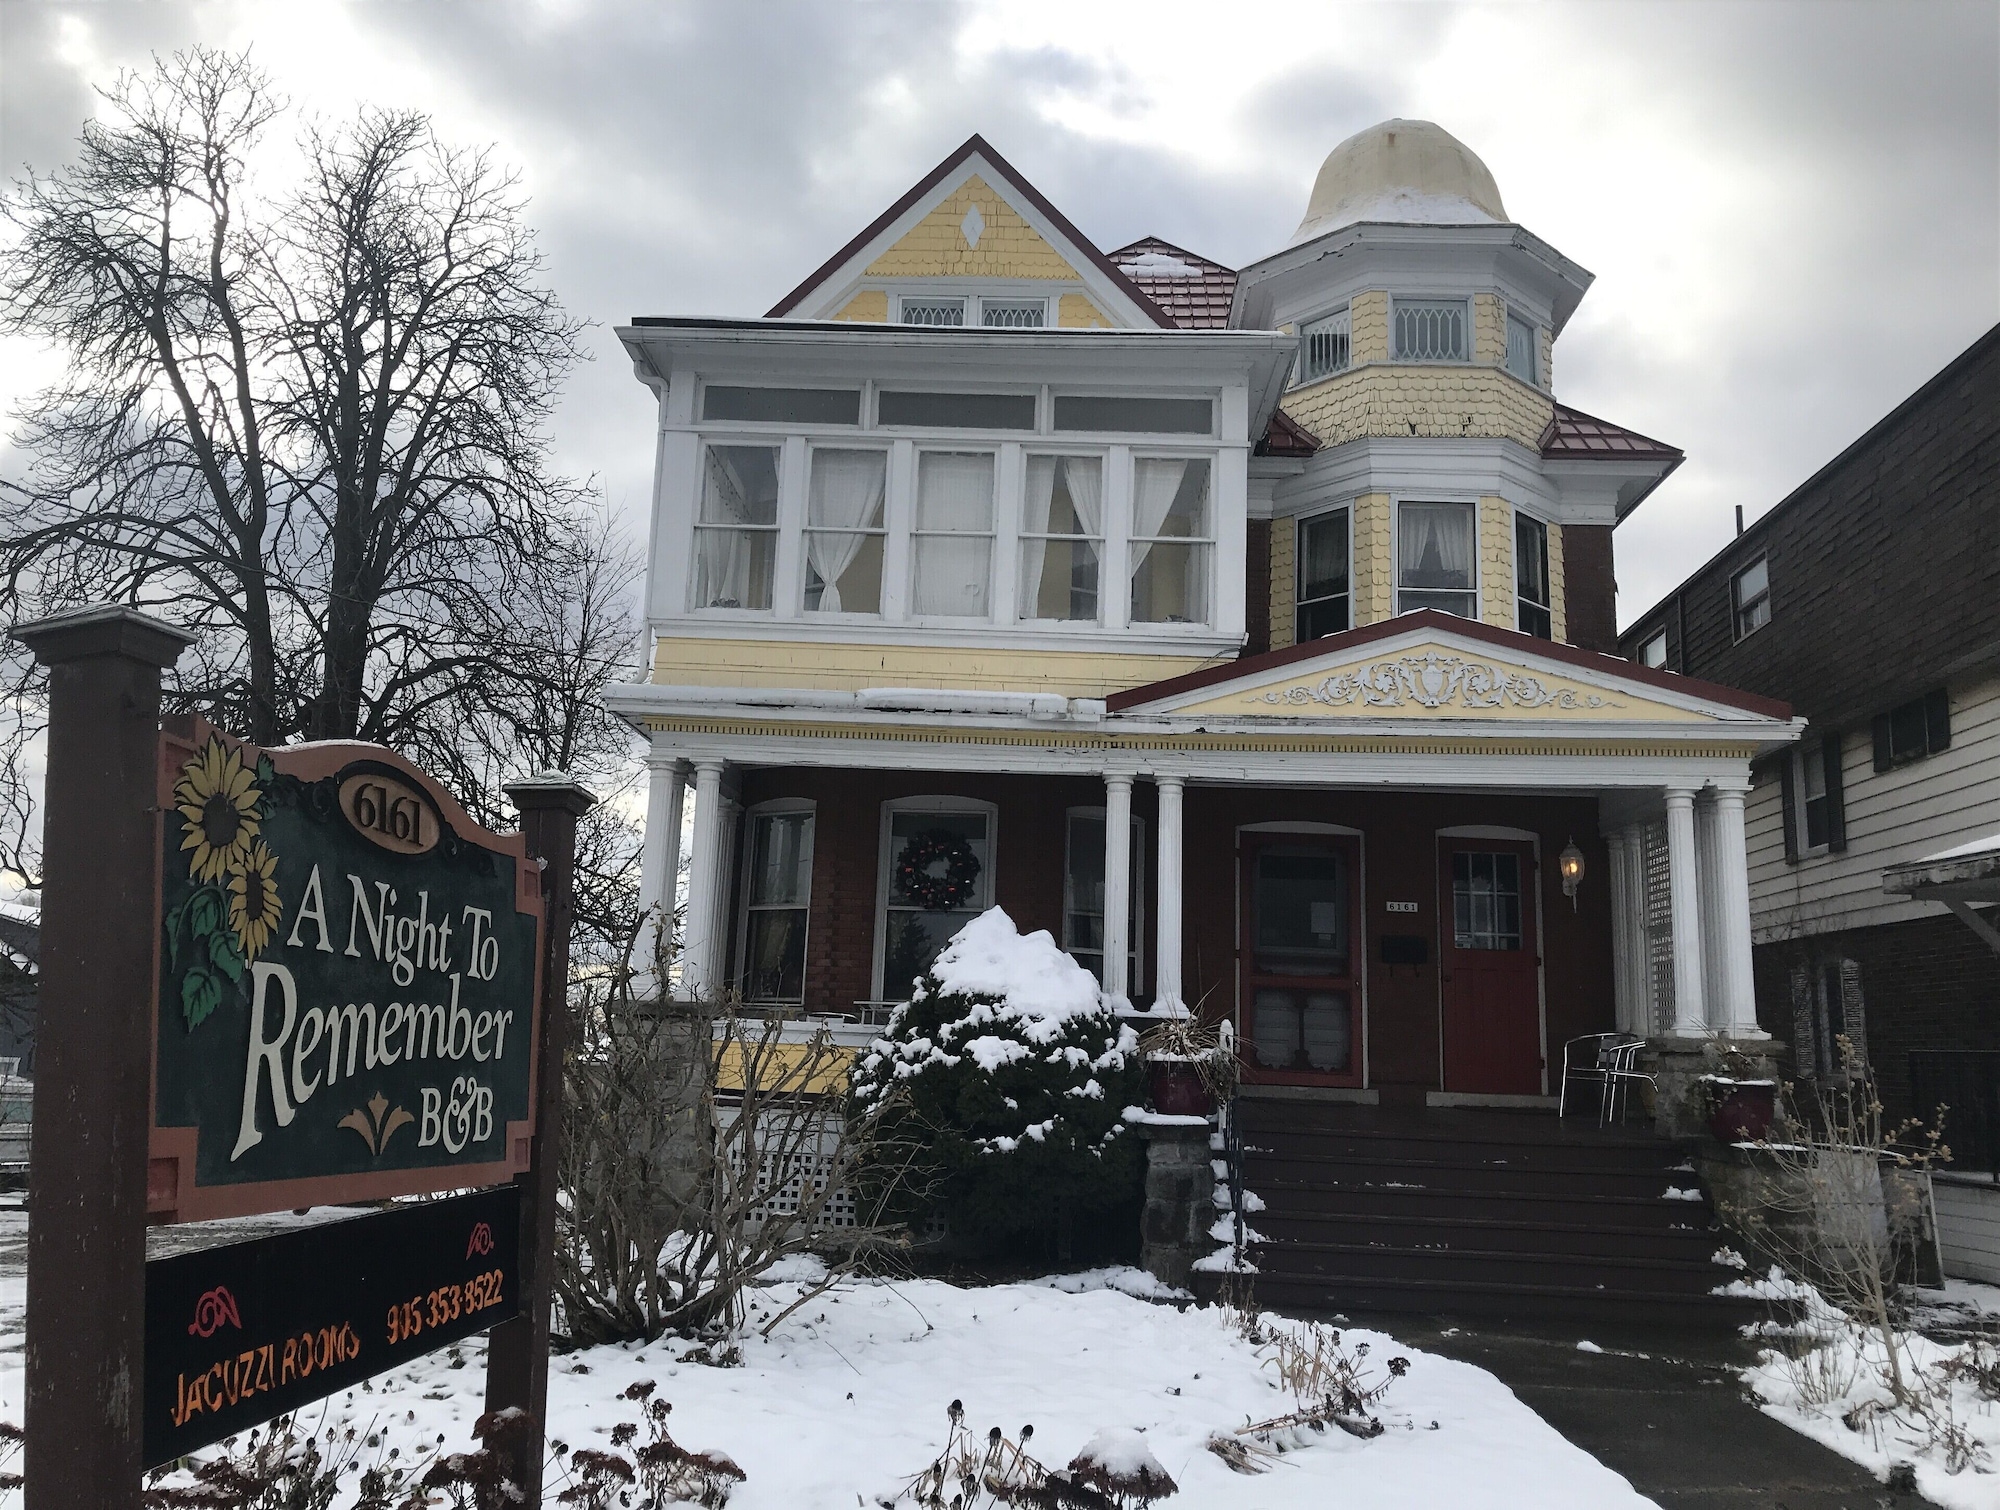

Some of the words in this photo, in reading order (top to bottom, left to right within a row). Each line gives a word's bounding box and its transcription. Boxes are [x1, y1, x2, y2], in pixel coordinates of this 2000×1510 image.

[353, 782, 424, 847] 6161
[287, 863, 334, 953] A
[345, 873, 453, 987] Night
[462, 905, 499, 981] To
[1389, 903, 1415, 911] 6161
[230, 960, 513, 1162] Remember
[417, 1076, 493, 1154] B&B
[170, 1344, 276, 1428] JACUZZI
[281, 1321, 361, 1386] ROOMS
[386, 1295, 422, 1345] 905
